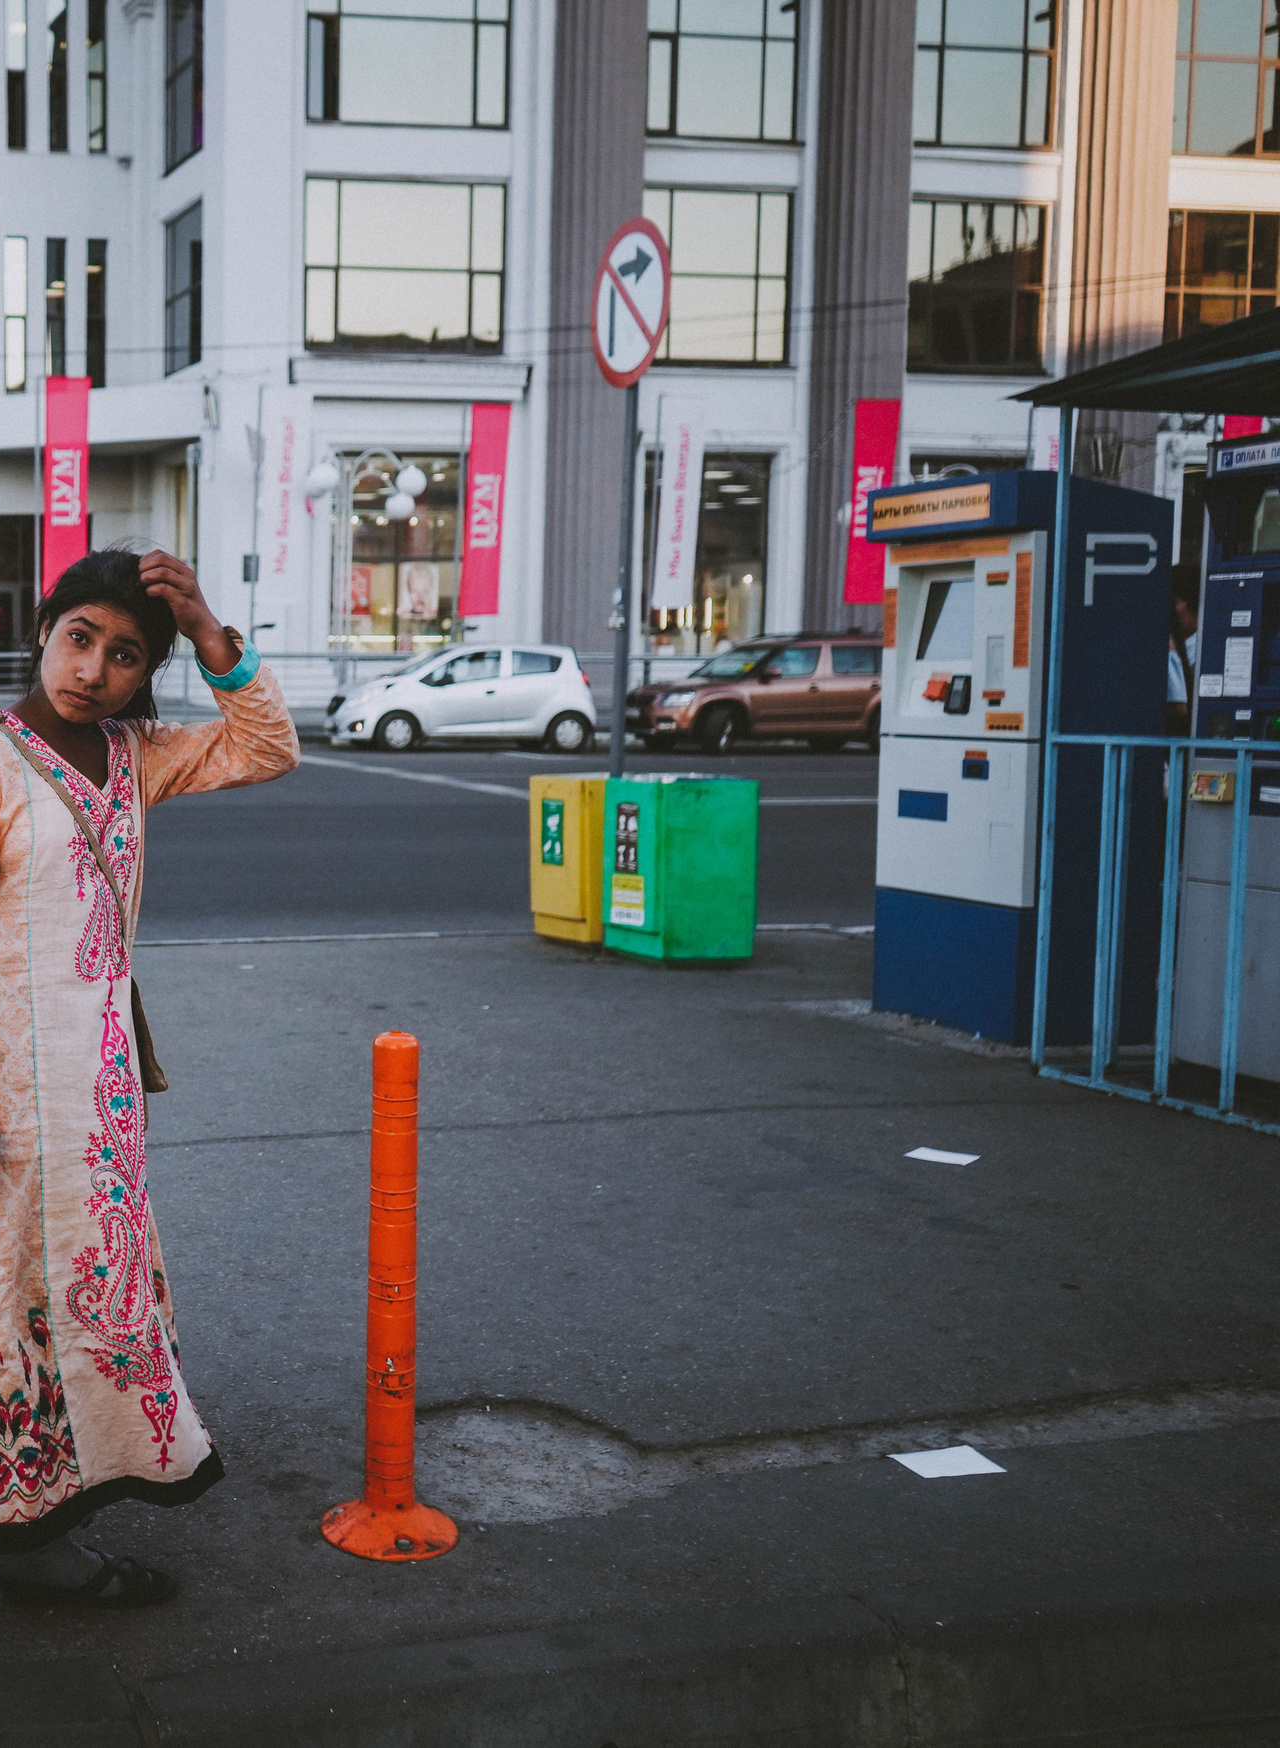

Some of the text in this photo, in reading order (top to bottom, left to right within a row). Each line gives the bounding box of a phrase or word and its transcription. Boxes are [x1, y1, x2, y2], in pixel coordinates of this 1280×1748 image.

[51, 448, 83, 527] ЦУМ
[1235, 449, 1266, 464] ОПЛАТА
[470, 473, 502, 548] ЦУМ
[903, 502, 939, 516] ОПЛАТЫ
[941, 494, 990, 511] ПАРКОВКИ
[1084, 533, 1158, 607] P
